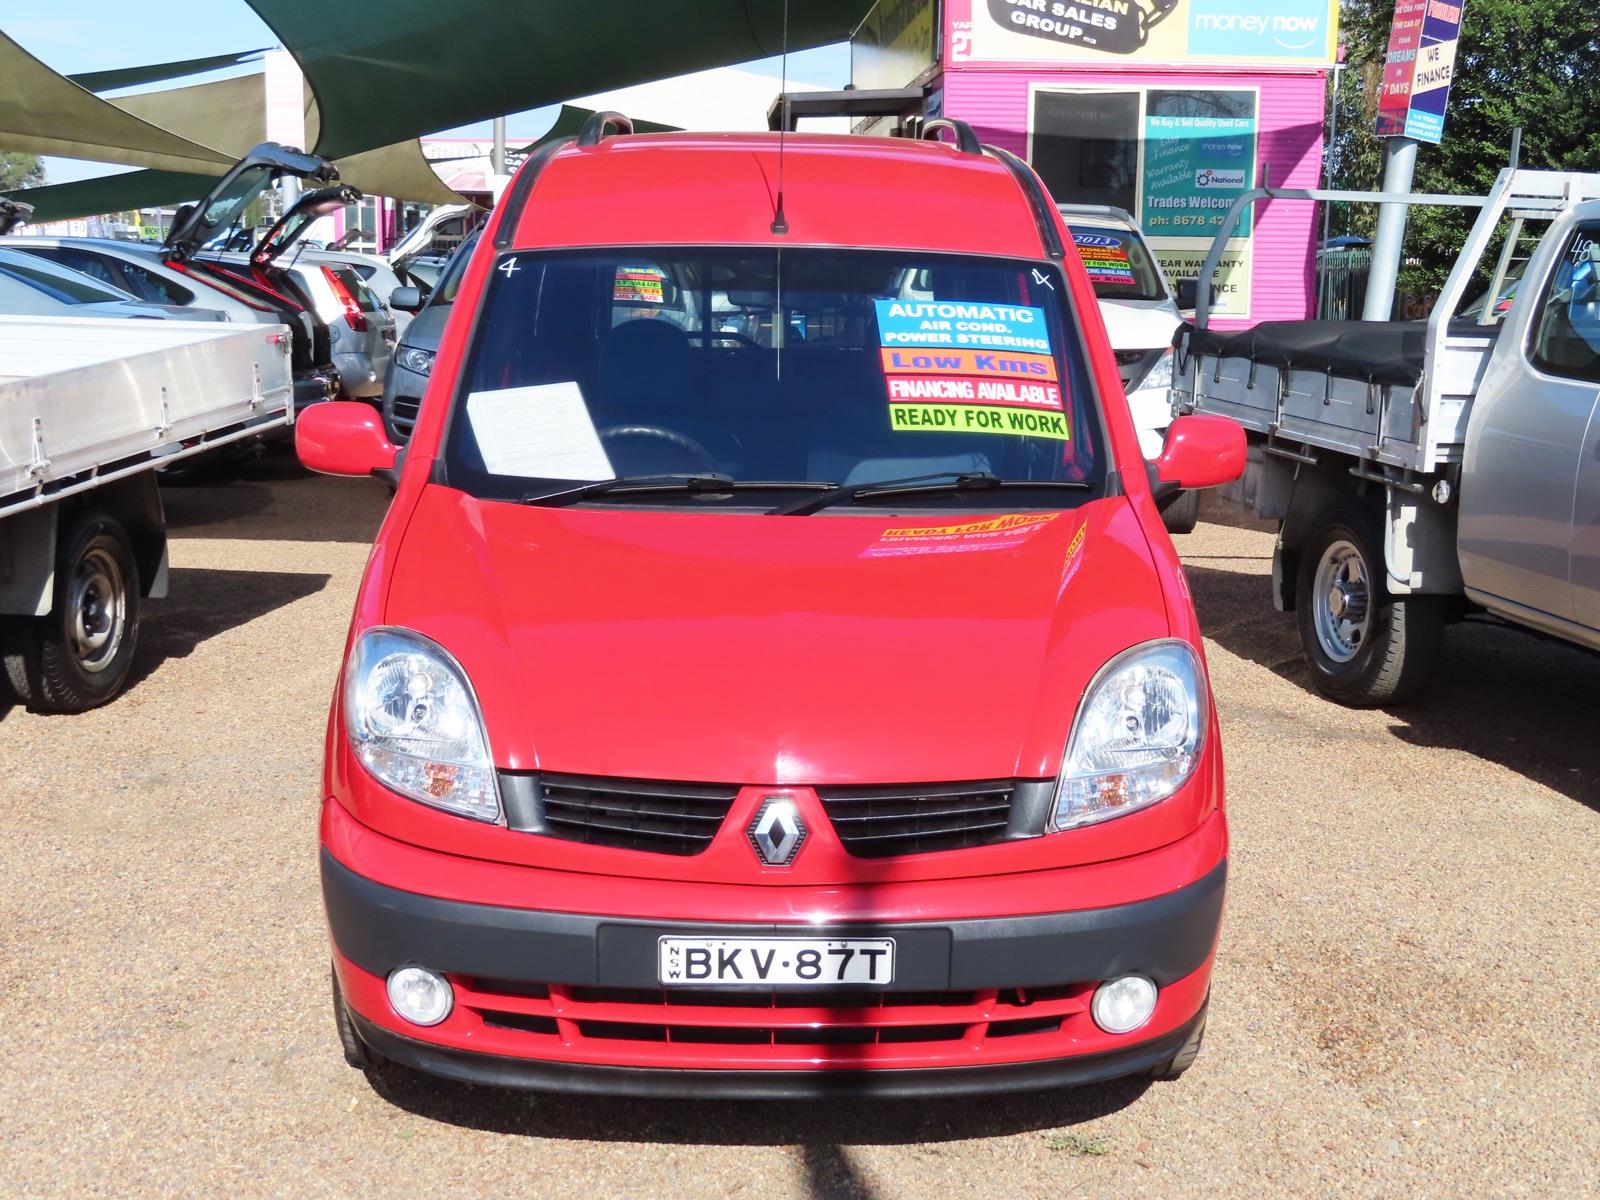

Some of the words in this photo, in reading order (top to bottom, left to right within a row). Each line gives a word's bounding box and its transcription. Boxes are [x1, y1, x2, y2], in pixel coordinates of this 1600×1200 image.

[1005, 0, 1046, 13] AR
[1051, 2, 1117, 31] SALES
[1010, 10, 1083, 39] GROUP
[1195, 14, 1270, 35] money
[1272, 16, 1319, 32] now
[1387, 48, 1416, 64] DREAMS
[1427, 47, 1439, 62] WE
[1417, 65, 1450, 87] FINANCE
[1390, 82, 1409, 95] DAYS
[1150, 118, 1160, 126] We
[1161, 118, 1174, 128] Buy
[1181, 119, 1194, 127] Sell
[1194, 119, 1217, 128] Quality
[1218, 119, 1233, 127] Used
[1146, 159, 1189, 179] Warranty
[1151, 170, 1193, 190] Available
[1211, 176, 1244, 184] National
[1147, 195, 1187, 209] Trades
[1190, 196, 1236, 209] Welcom
[1150, 215, 1169, 226] ph:
[1173, 215, 1205, 226] 8678
[1074, 235, 1111, 245] 2013
[1571, 232, 1593, 264] 48
[1162, 269, 1219, 277] AVAILAE
[888, 303, 1034, 323] AUTOMATIC
[920, 320, 951, 331] AIR
[956, 321, 1012, 334] COND.
[885, 332, 952, 343] POWER
[957, 333, 1048, 349] STEERING
[892, 352, 962, 369] Low
[975, 355, 1048, 375] Kms
[889, 380, 974, 399] FINANCING
[978, 381, 1060, 405] AVAILABLE
[894, 408, 958, 426] READY
[965, 409, 1003, 428] FOR
[1009, 412, 1065, 434] WORK
